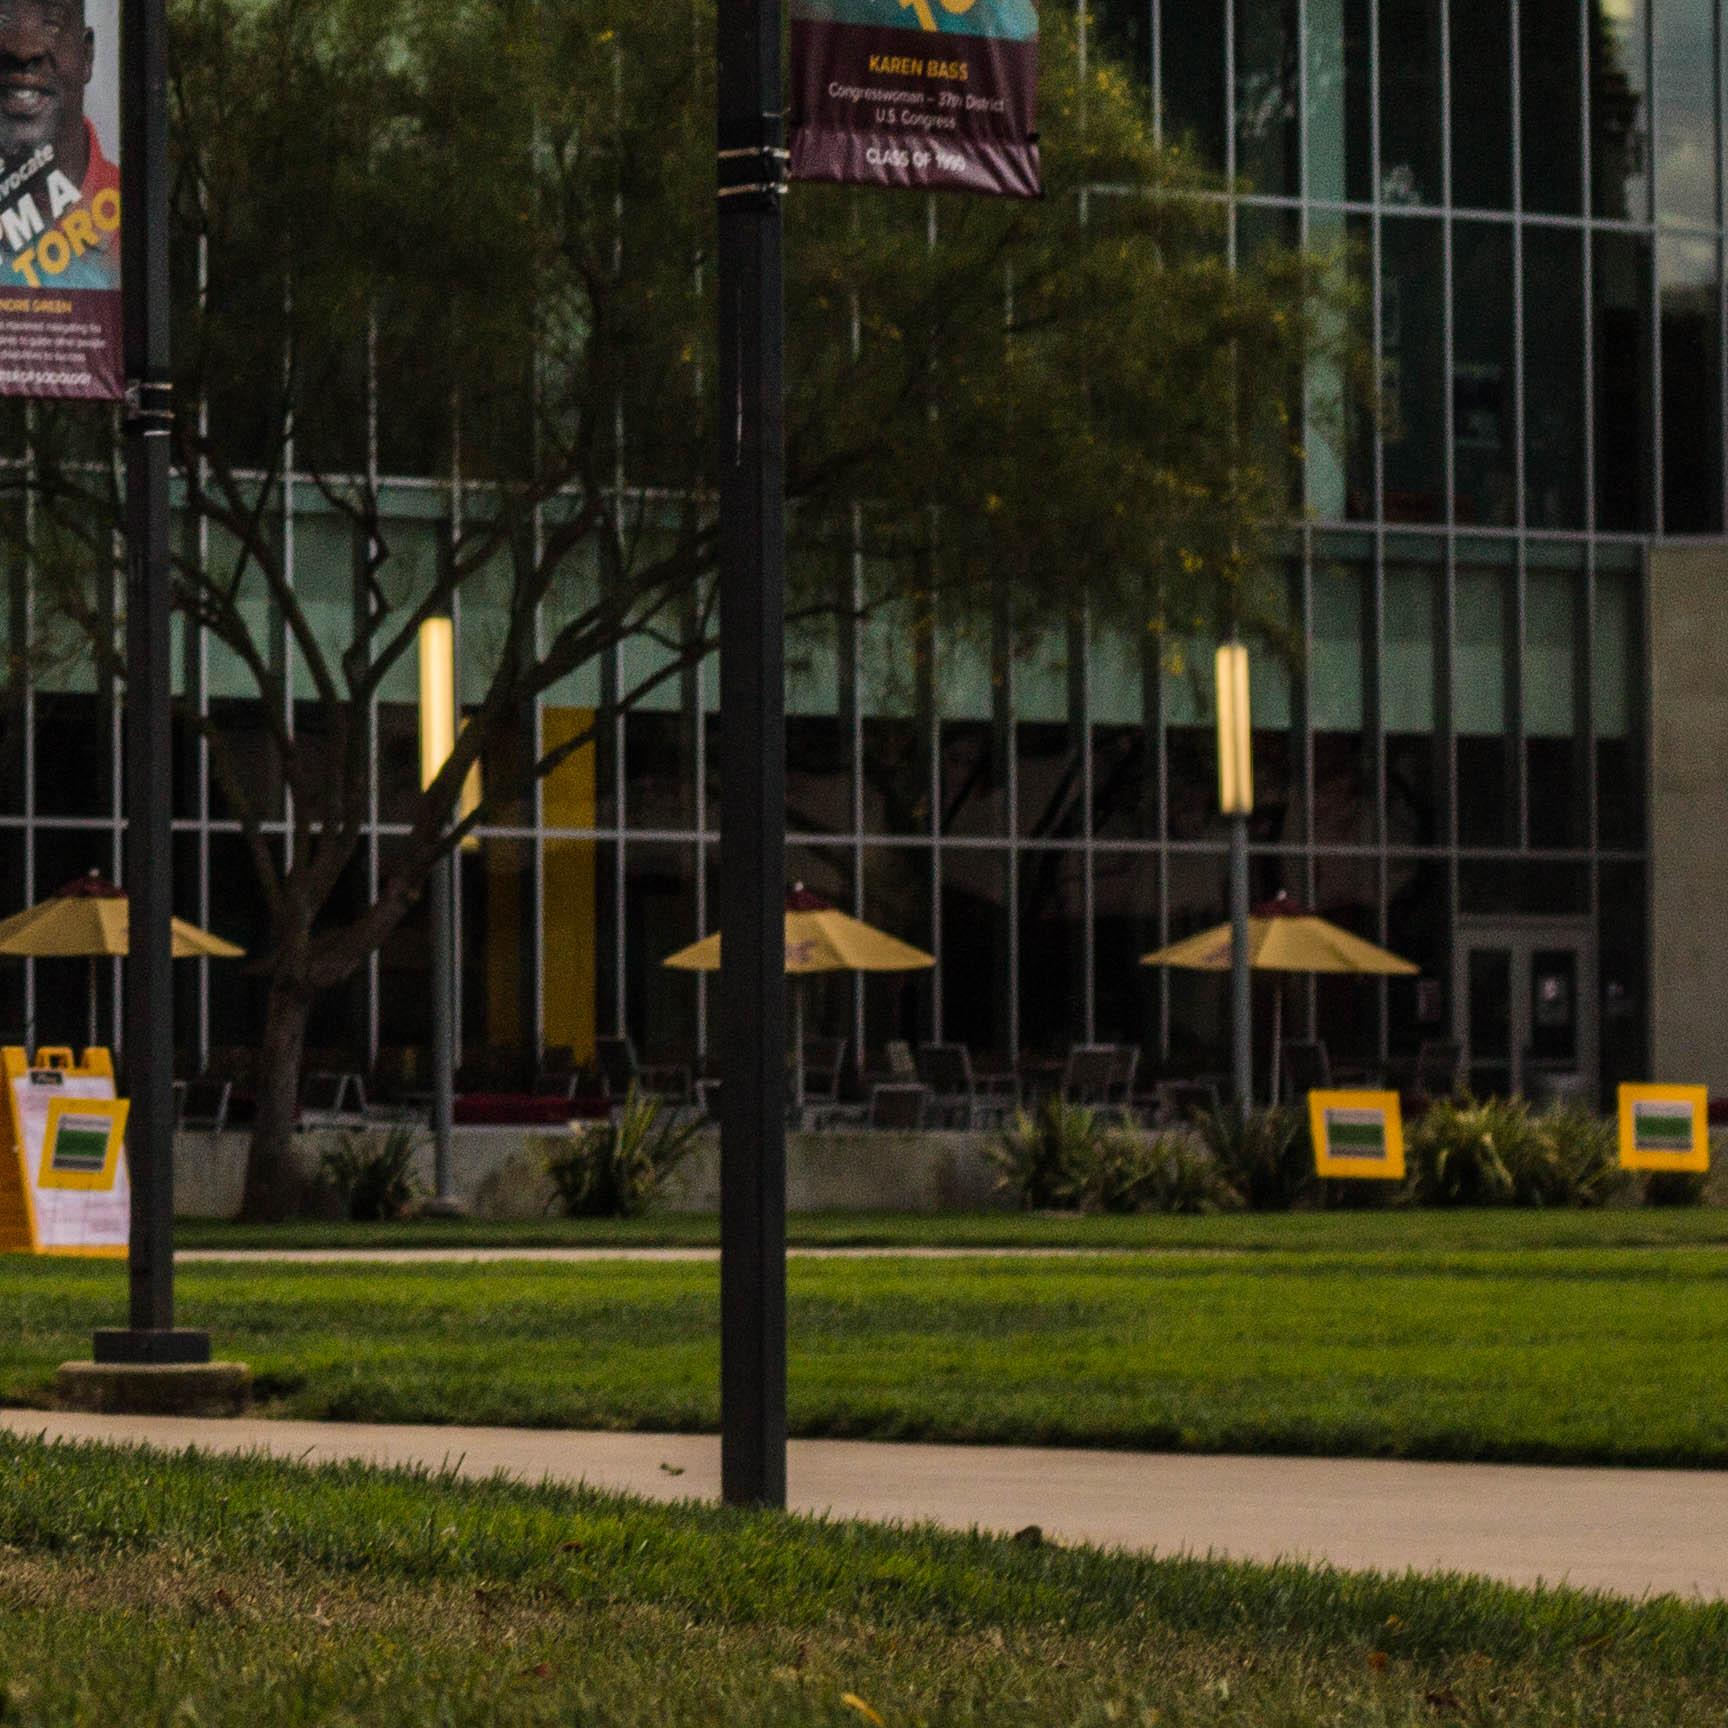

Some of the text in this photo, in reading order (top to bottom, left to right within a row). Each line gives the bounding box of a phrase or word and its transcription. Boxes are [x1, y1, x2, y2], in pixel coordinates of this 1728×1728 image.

[869, 55, 969, 81] KAREN BASS
[828, 82, 924, 103] Congresswoman
[965, 94, 1005, 113] District
[900, 110, 956, 129] Congress
[866, 147, 910, 168] CLASS
[912, 150, 932, 168] OF
[46, 168, 84, 219] A
[11, 187, 121, 289] TORO
